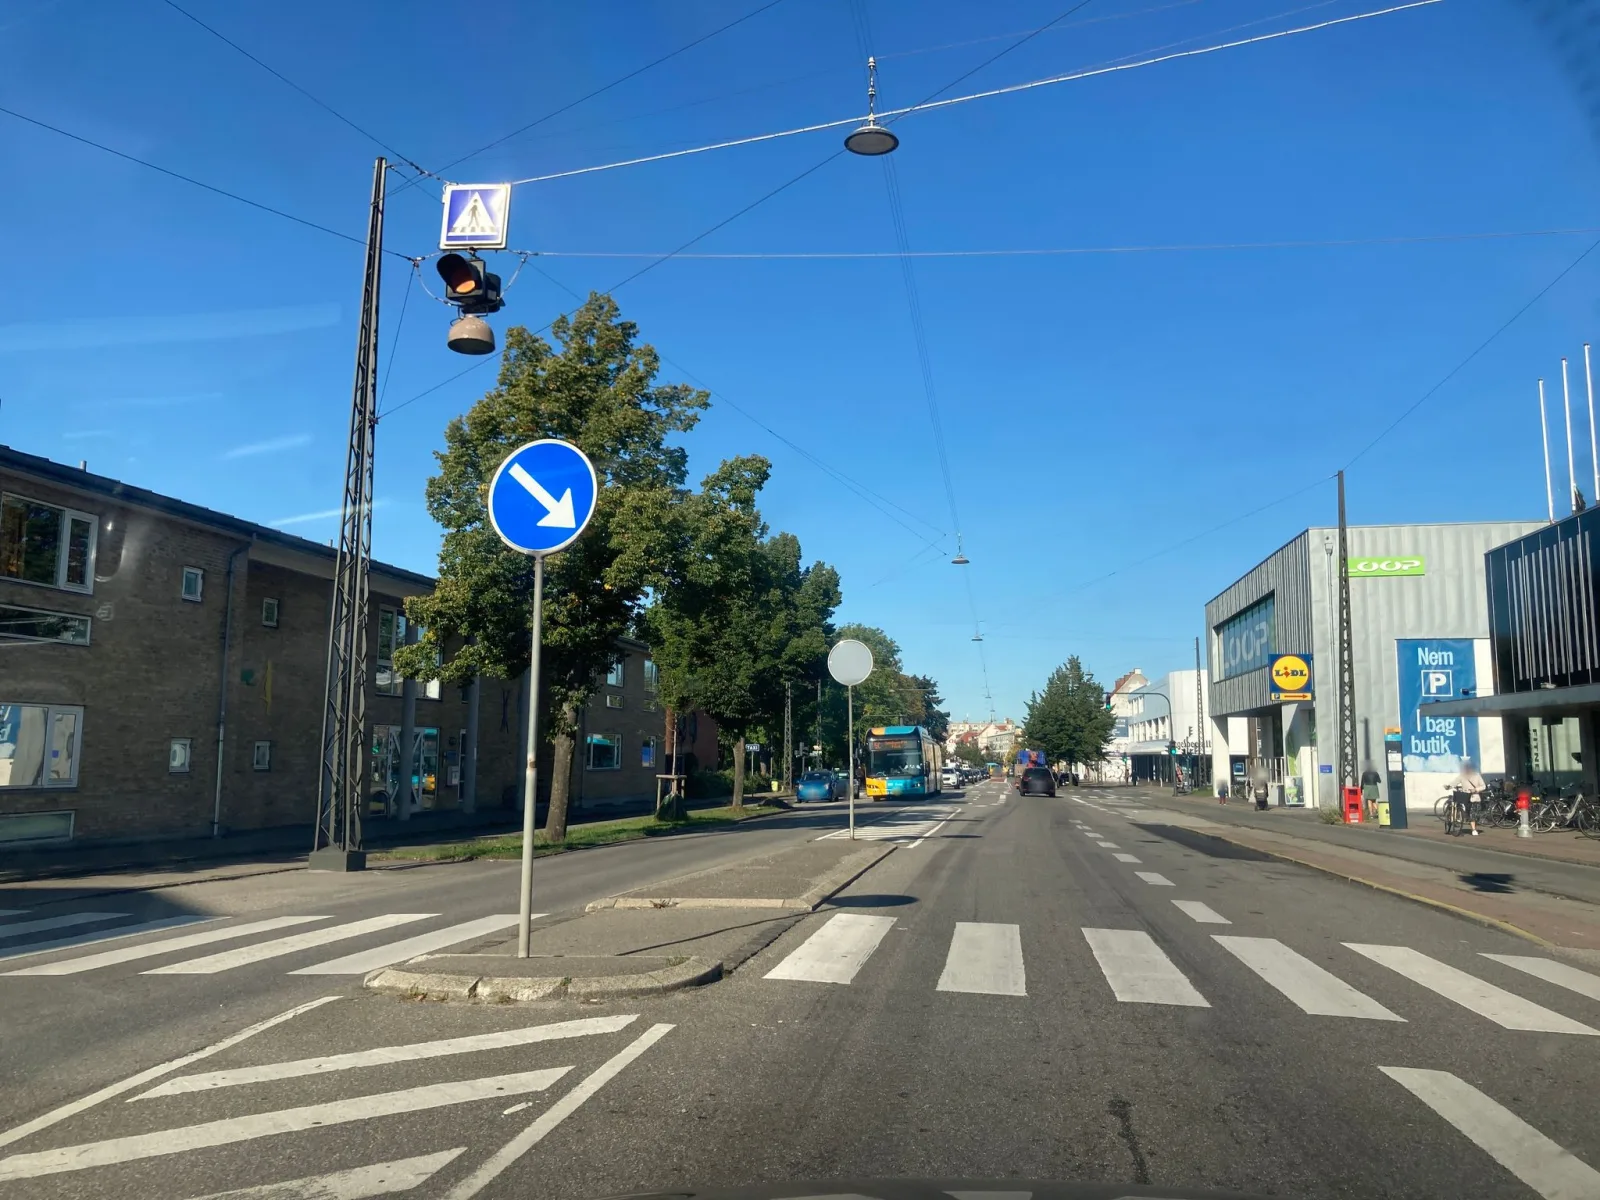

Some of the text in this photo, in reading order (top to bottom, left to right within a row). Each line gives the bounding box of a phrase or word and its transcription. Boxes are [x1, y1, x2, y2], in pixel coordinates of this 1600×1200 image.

[1417, 646, 1454, 666] Nem
[1428, 672, 1447, 694] P
[1425, 716, 1457, 737] bag
[1410, 735, 1452, 755] butik
